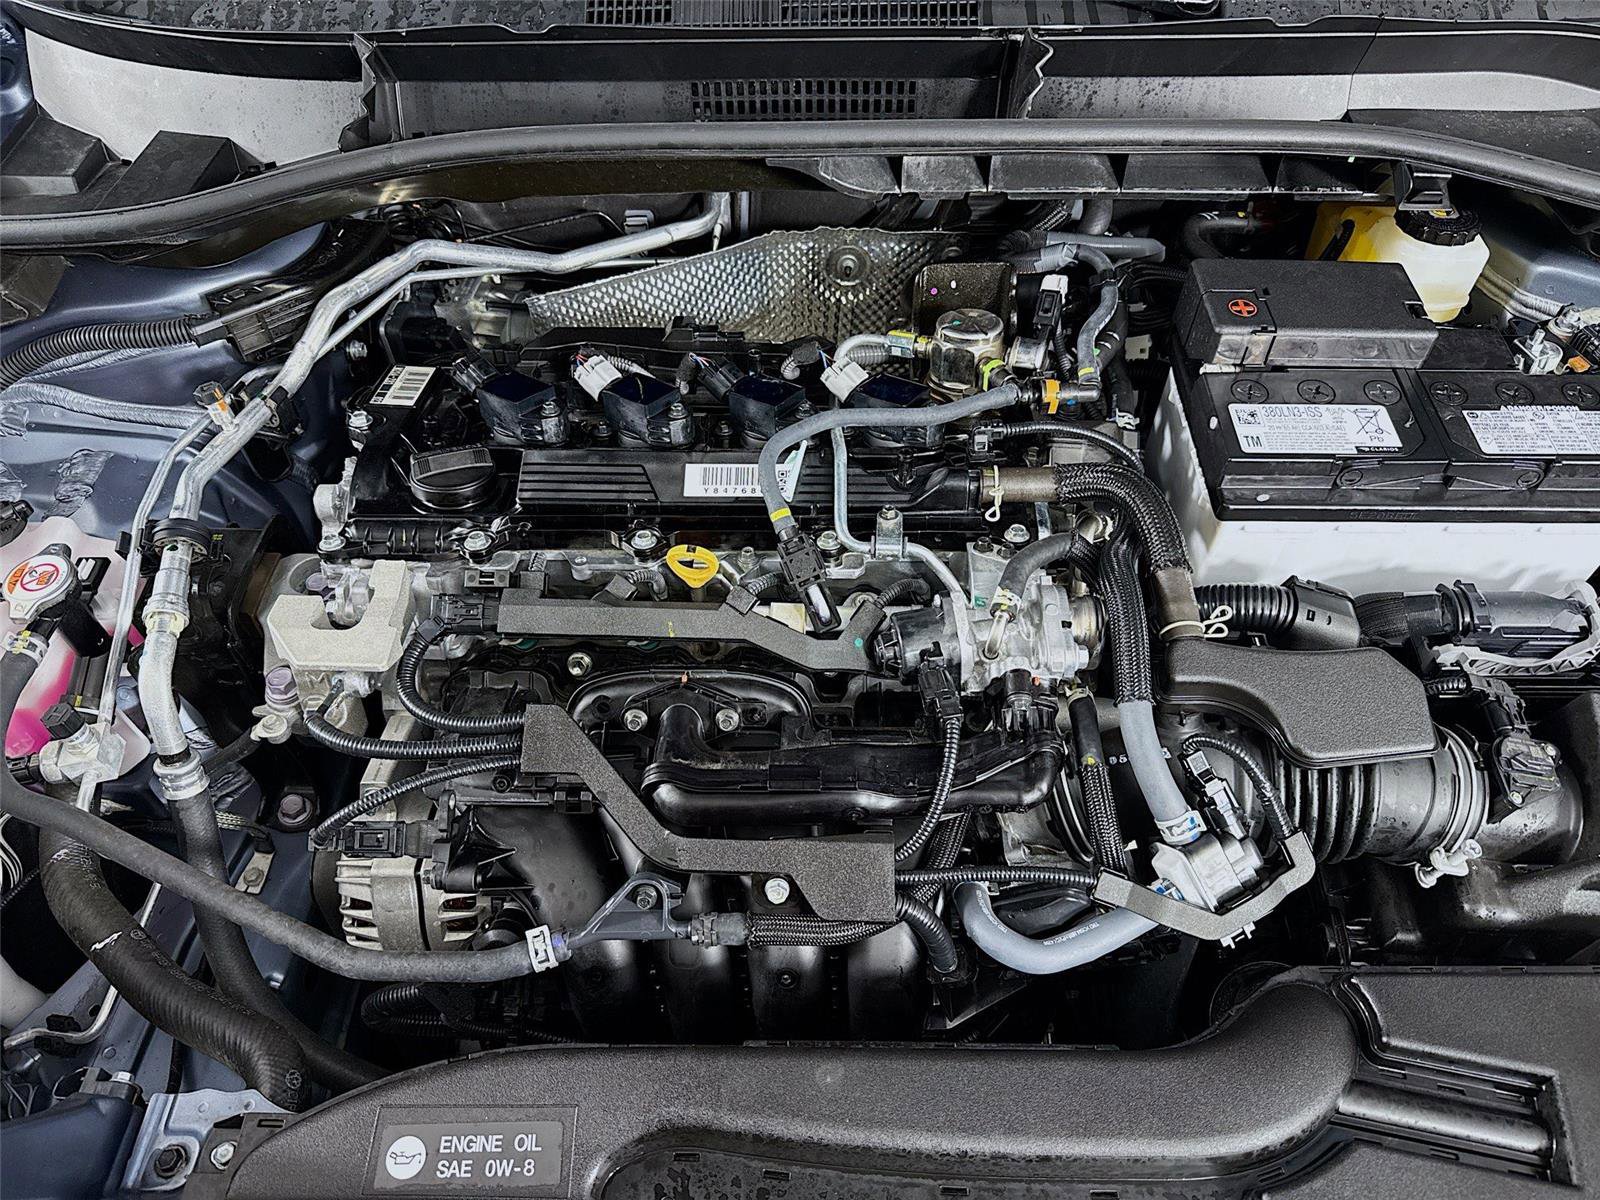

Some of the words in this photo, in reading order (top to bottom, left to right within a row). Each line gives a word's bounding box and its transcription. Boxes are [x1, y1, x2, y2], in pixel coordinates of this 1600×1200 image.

[1262, 406, 1322, 417] 380LN3-ISS
[1243, 436, 1262, 447] TM
[440, 1135, 503, 1153] ENGINE
[514, 1134, 542, 1152] OIL
[436, 1160, 473, 1178] SAE
[485, 1159, 535, 1178] 0W-8
